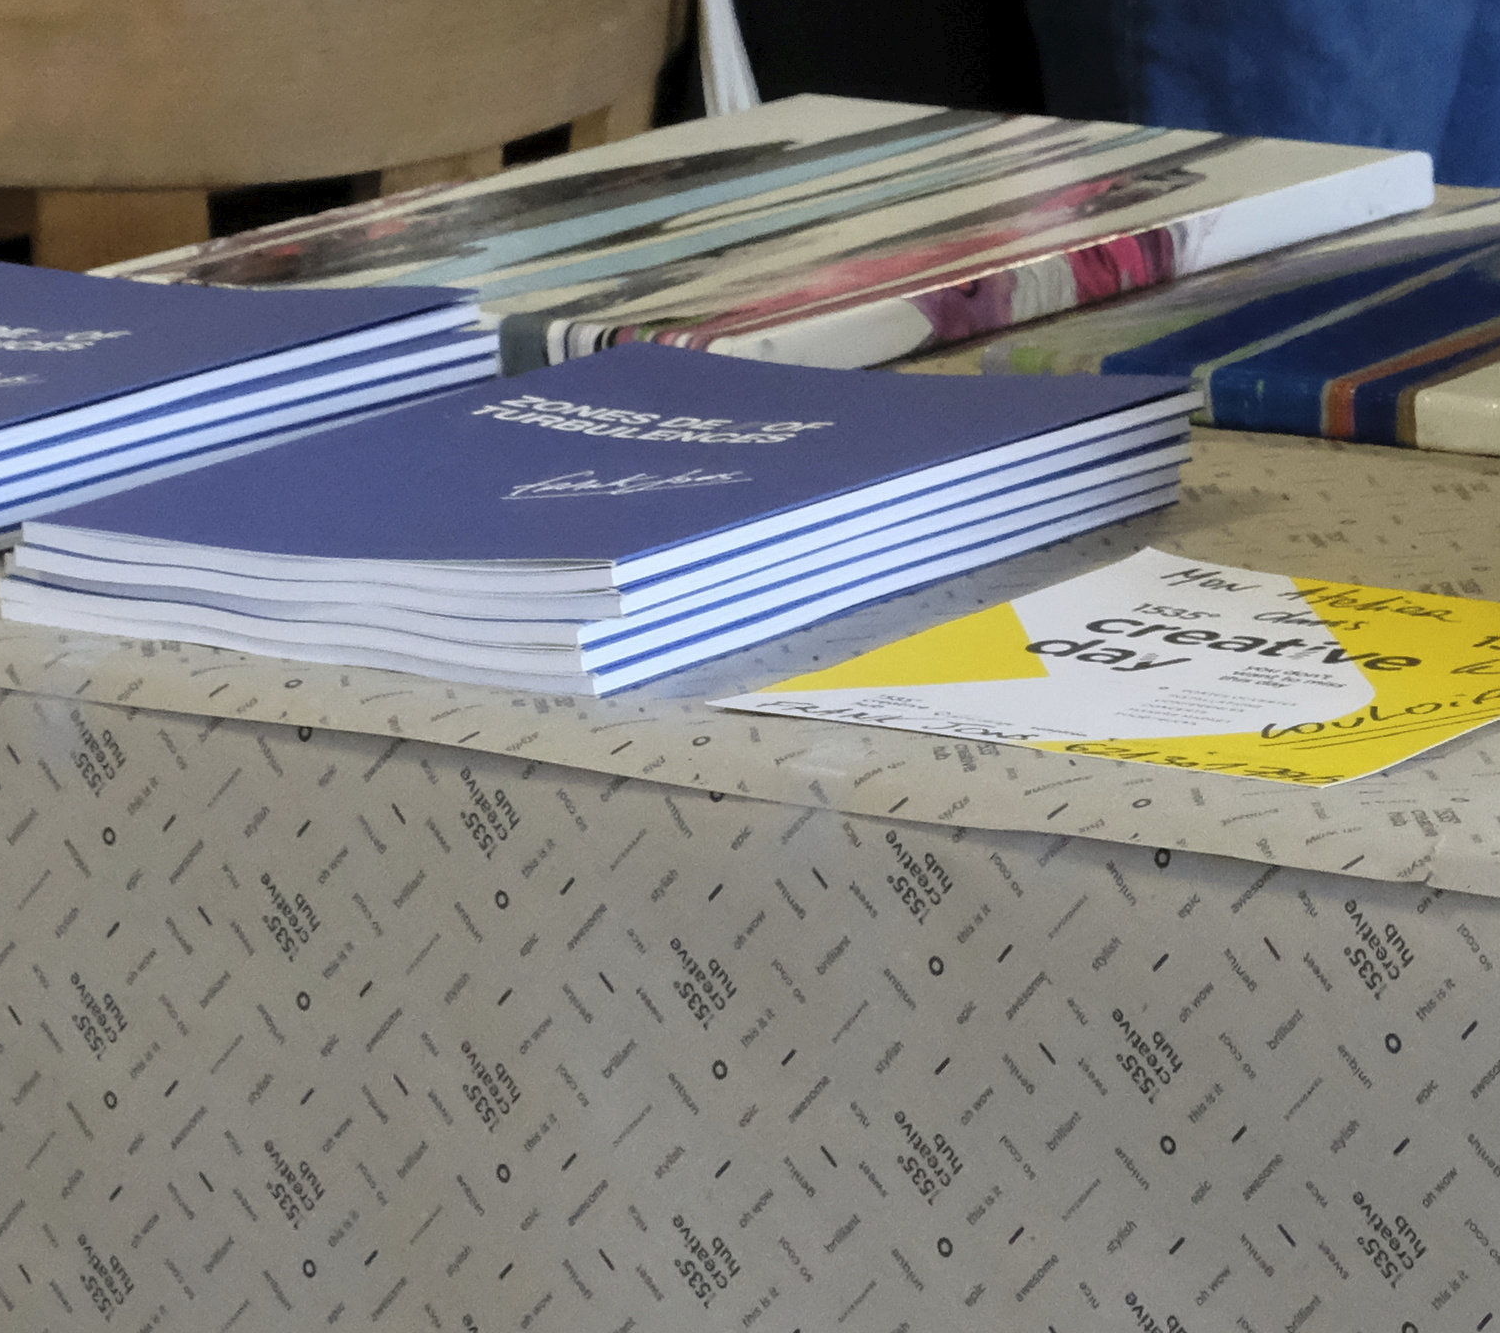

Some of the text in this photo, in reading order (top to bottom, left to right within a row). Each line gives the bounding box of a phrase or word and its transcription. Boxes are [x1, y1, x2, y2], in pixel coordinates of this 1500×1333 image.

[471, 405, 797, 444] TURBULENCES
[500, 394, 835, 433] ZONES DE OF
[1025, 639, 1193, 672] day
[1085, 618, 1422, 671] creative
[1112, 1008, 1171, 1085] creative
[1152, 1031, 1182, 1073] hub
[1116, 1053, 1157, 1105] 1535°
[1352, 1191, 1413, 1269] creative
[1394, 1215, 1426, 1259] hub
[1356, 1236, 1402, 1289] 1535°
